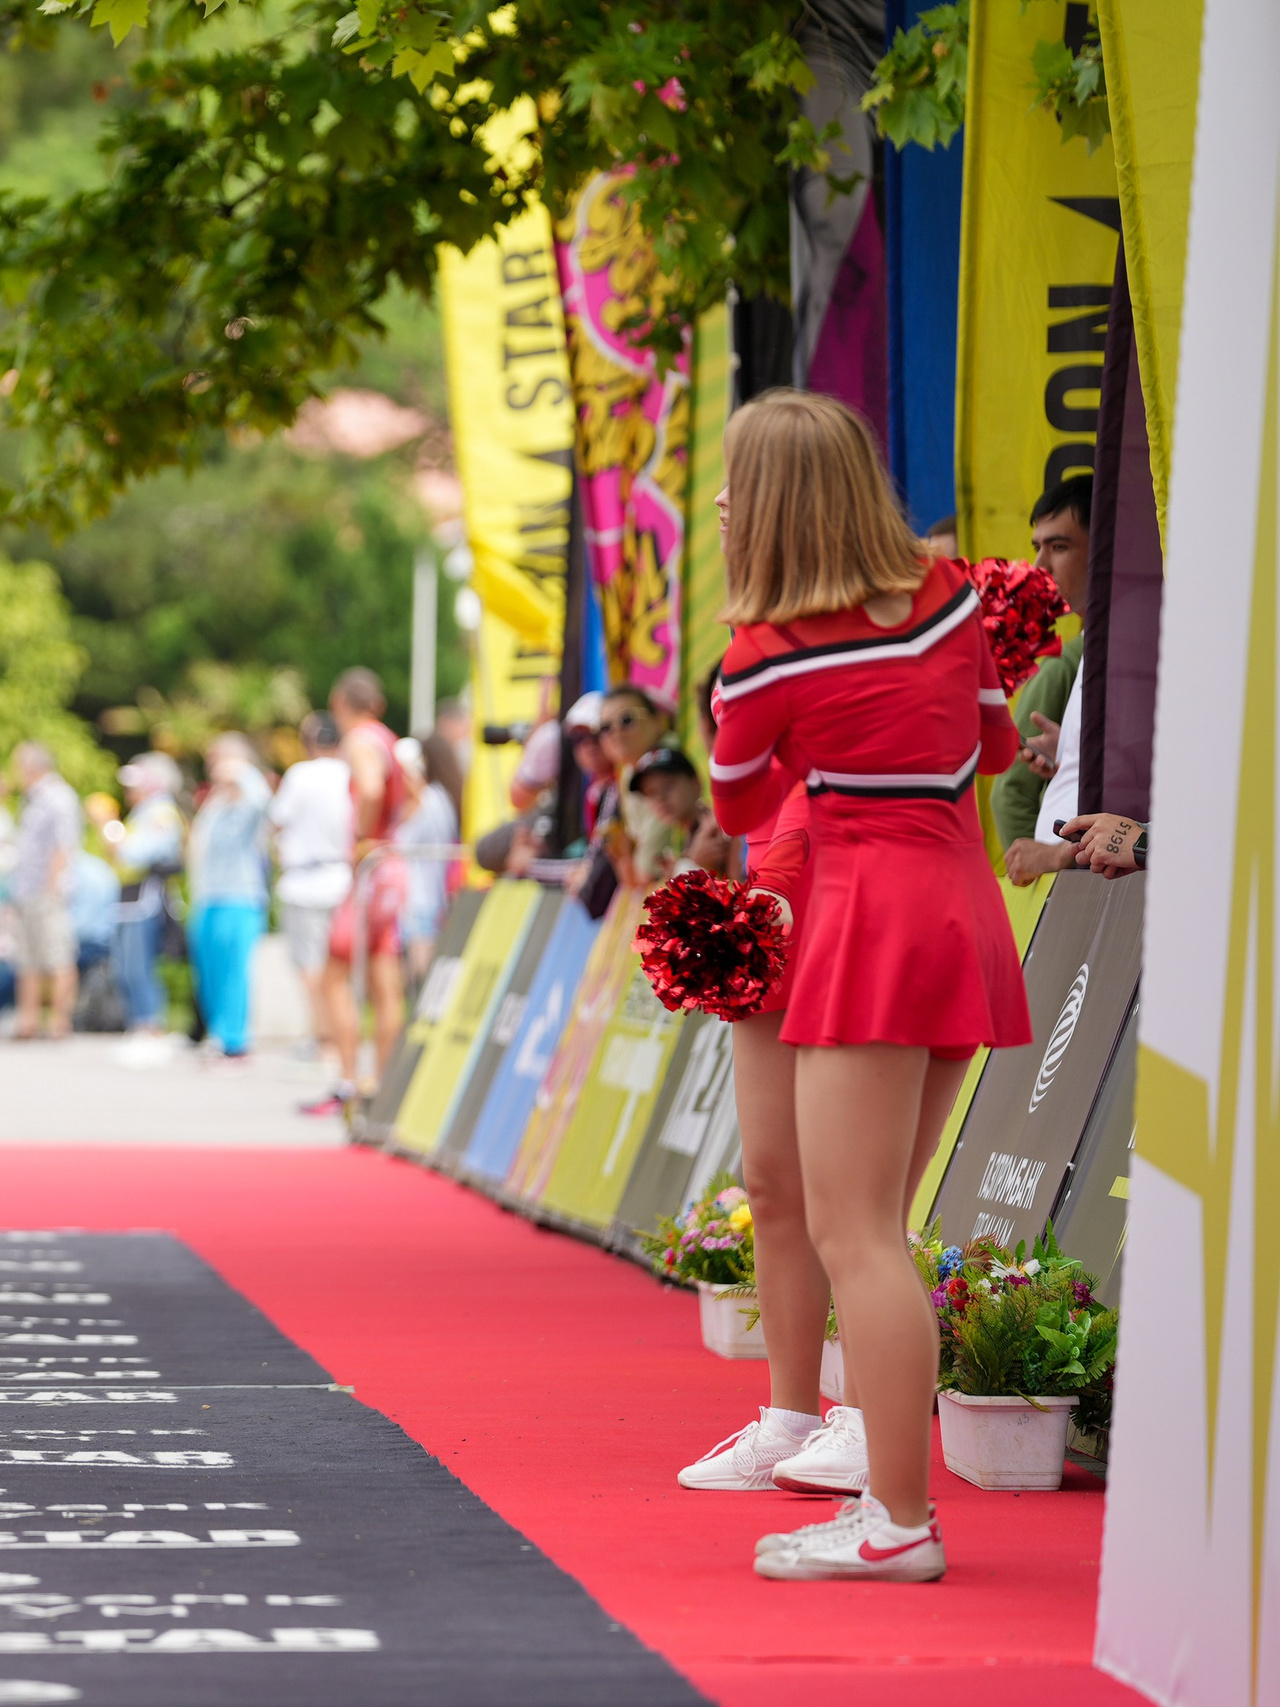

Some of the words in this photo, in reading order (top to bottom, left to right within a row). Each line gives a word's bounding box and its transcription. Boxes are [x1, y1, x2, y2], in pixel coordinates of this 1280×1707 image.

[499, 244, 570, 413] STAR
[1106, 821, 1132, 854] 5198
[977, 1151, 1047, 1210] ГАЗПРОМБАНК
